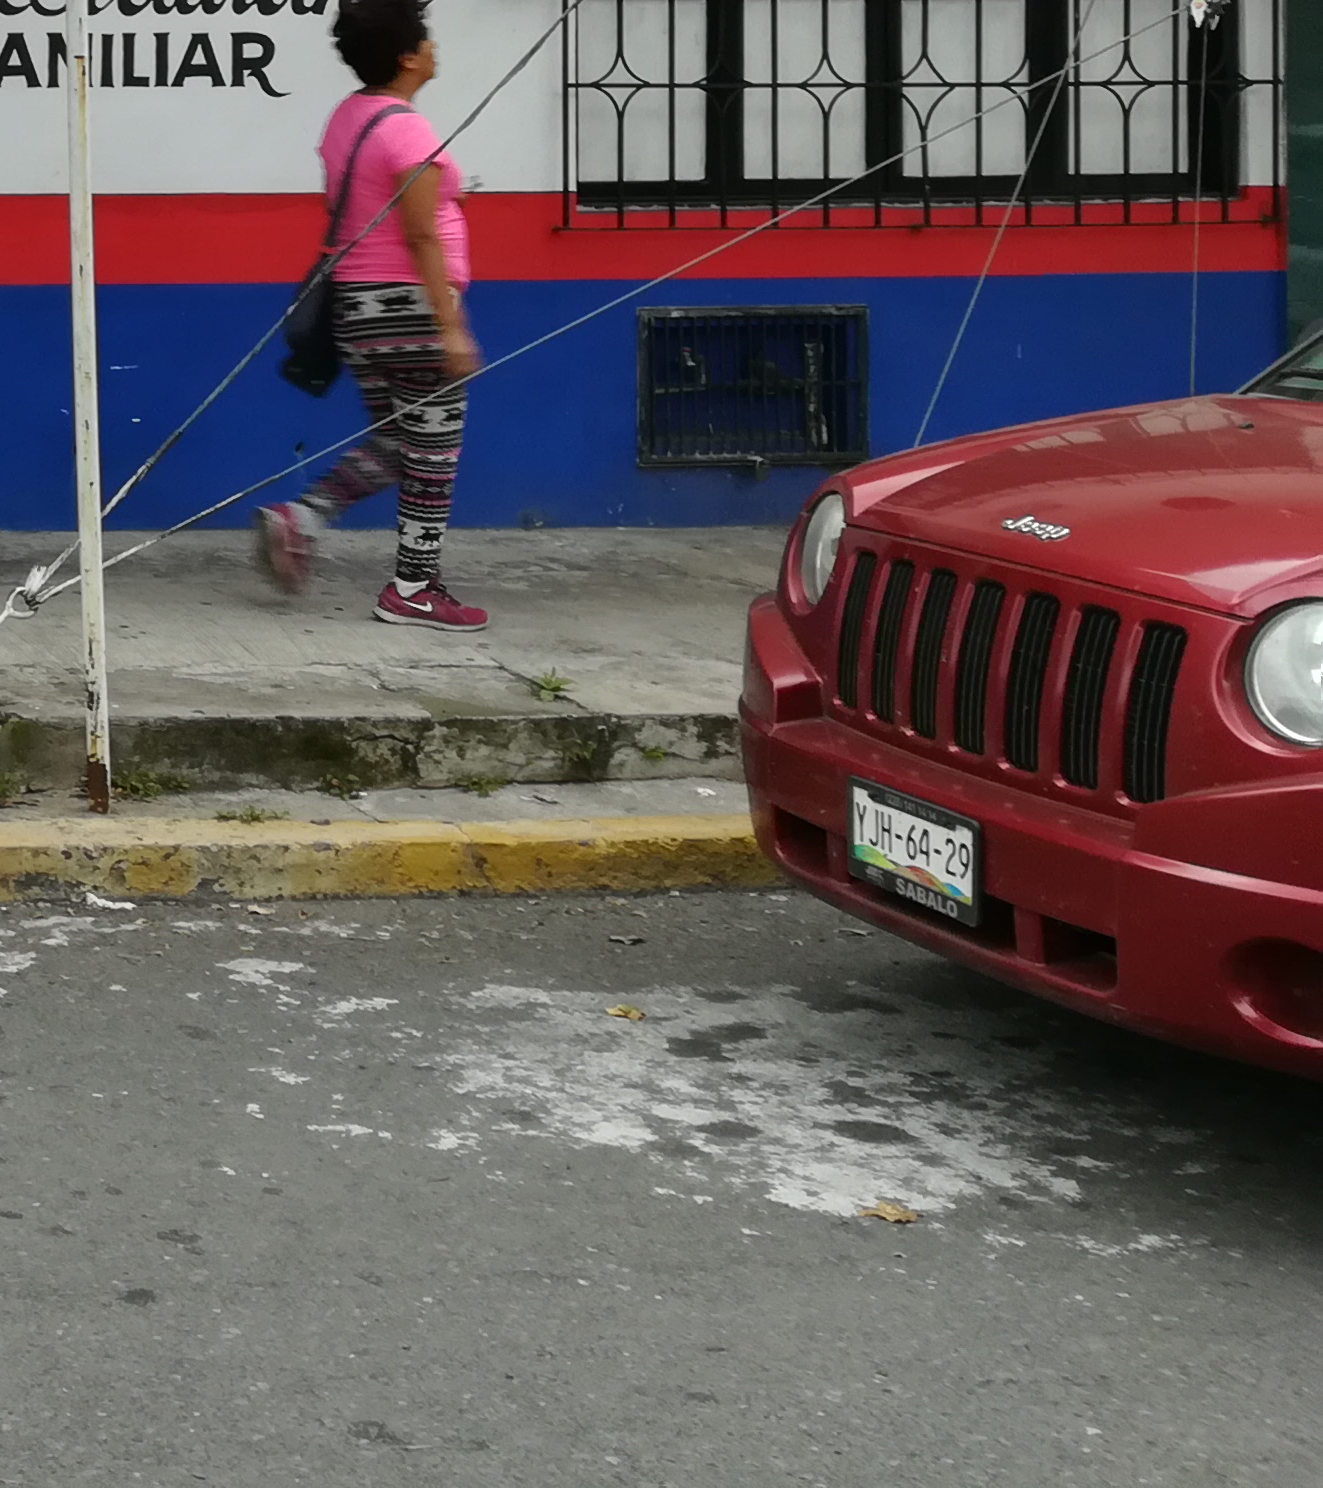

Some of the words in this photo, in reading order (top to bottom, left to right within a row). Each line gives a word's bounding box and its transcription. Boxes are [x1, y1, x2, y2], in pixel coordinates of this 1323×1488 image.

[1001, 514, 1071, 541] Jeep
[856, 801, 971, 880] YJH-64-29
[895, 877, 958, 918] SABALO
